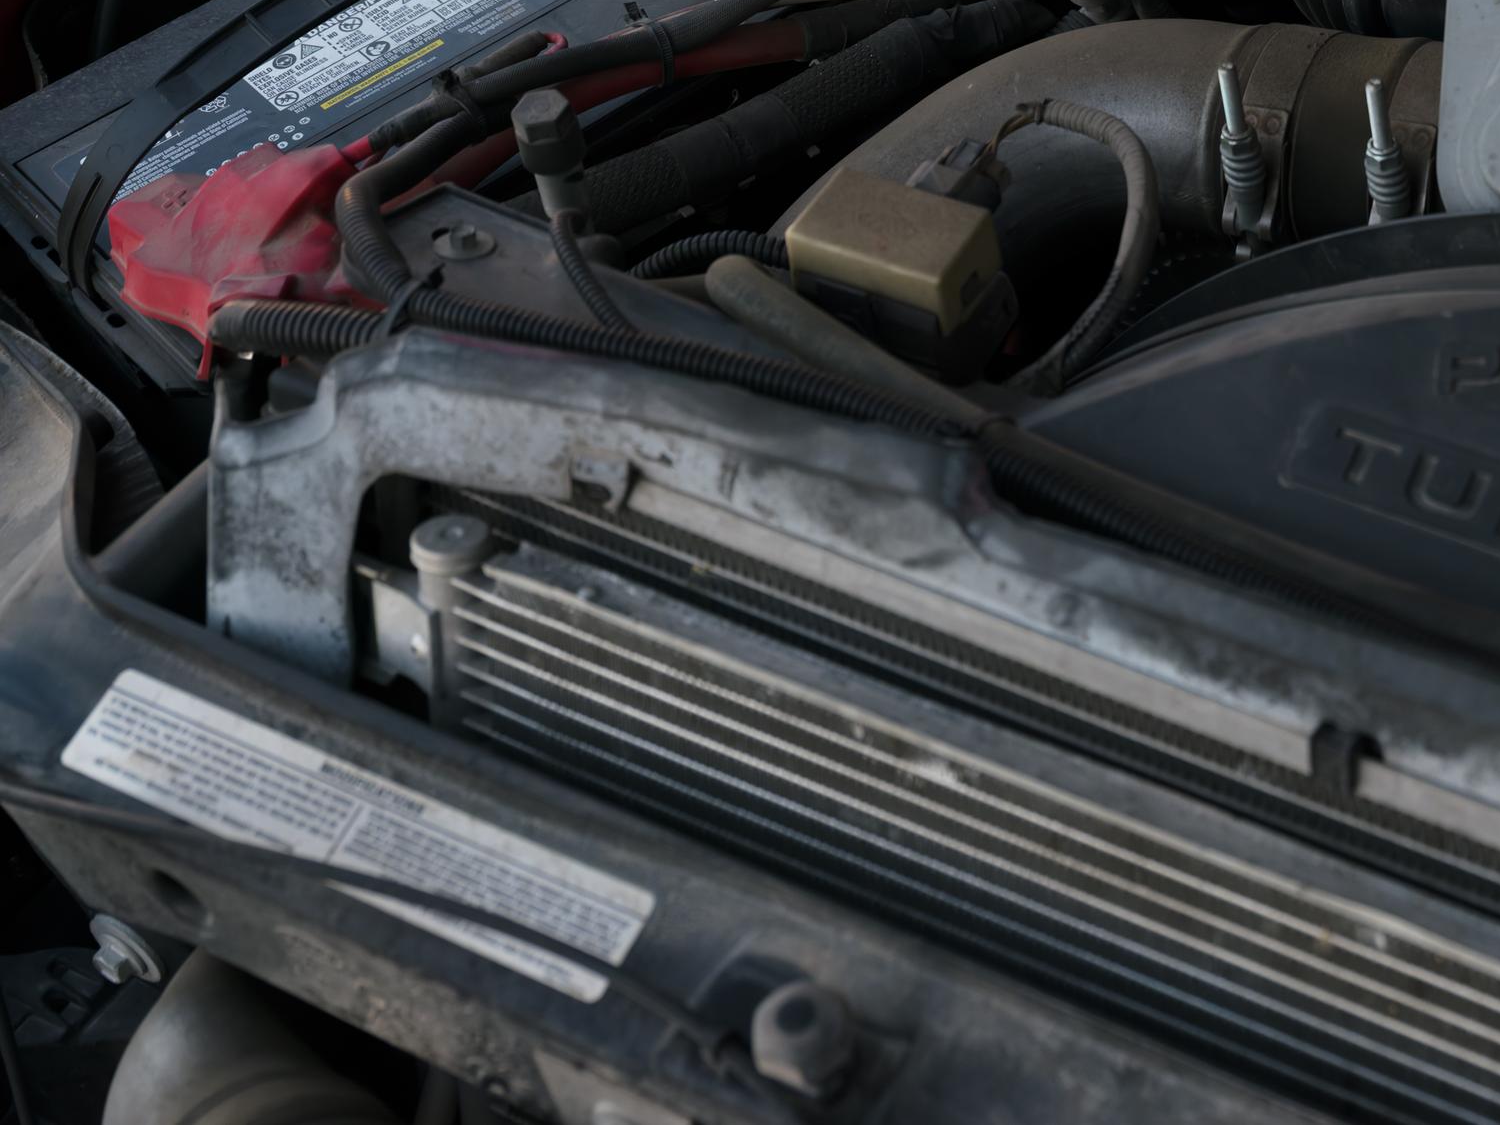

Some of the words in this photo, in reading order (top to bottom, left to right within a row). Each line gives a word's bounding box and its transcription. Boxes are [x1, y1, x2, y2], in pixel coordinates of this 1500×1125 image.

[372, 9, 389, 19] ACID
[248, 67, 272, 81] SHIELD
[257, 68, 295, 90] EXPLOSIVE
[295, 56, 317, 69] GASES
[297, 80, 313, 89] KEEP
[312, 73, 325, 81] OUT
[301, 81, 322, 93] REACH
